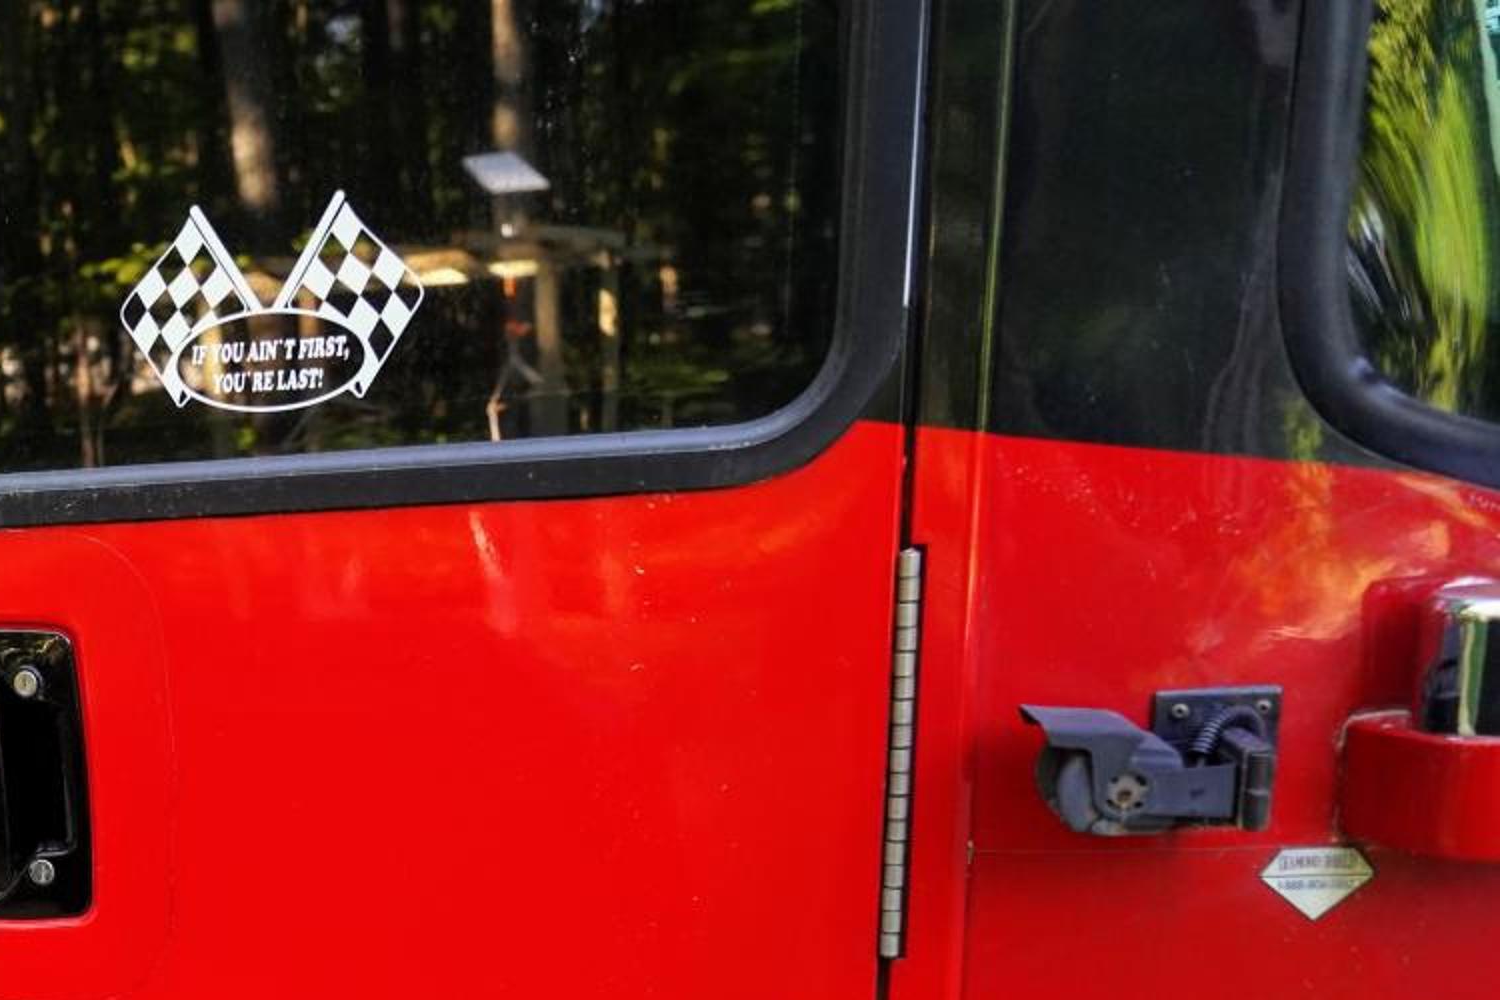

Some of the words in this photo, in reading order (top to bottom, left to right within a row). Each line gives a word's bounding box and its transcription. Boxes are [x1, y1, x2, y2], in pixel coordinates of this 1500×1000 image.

[191, 345, 207, 365] IF
[209, 341, 245, 364] YOU
[246, 338, 297, 362] AIN'T
[298, 335, 349, 360] FIRST,
[213, 370, 274, 394] YOU'RE
[276, 368, 324, 391] LAST!
